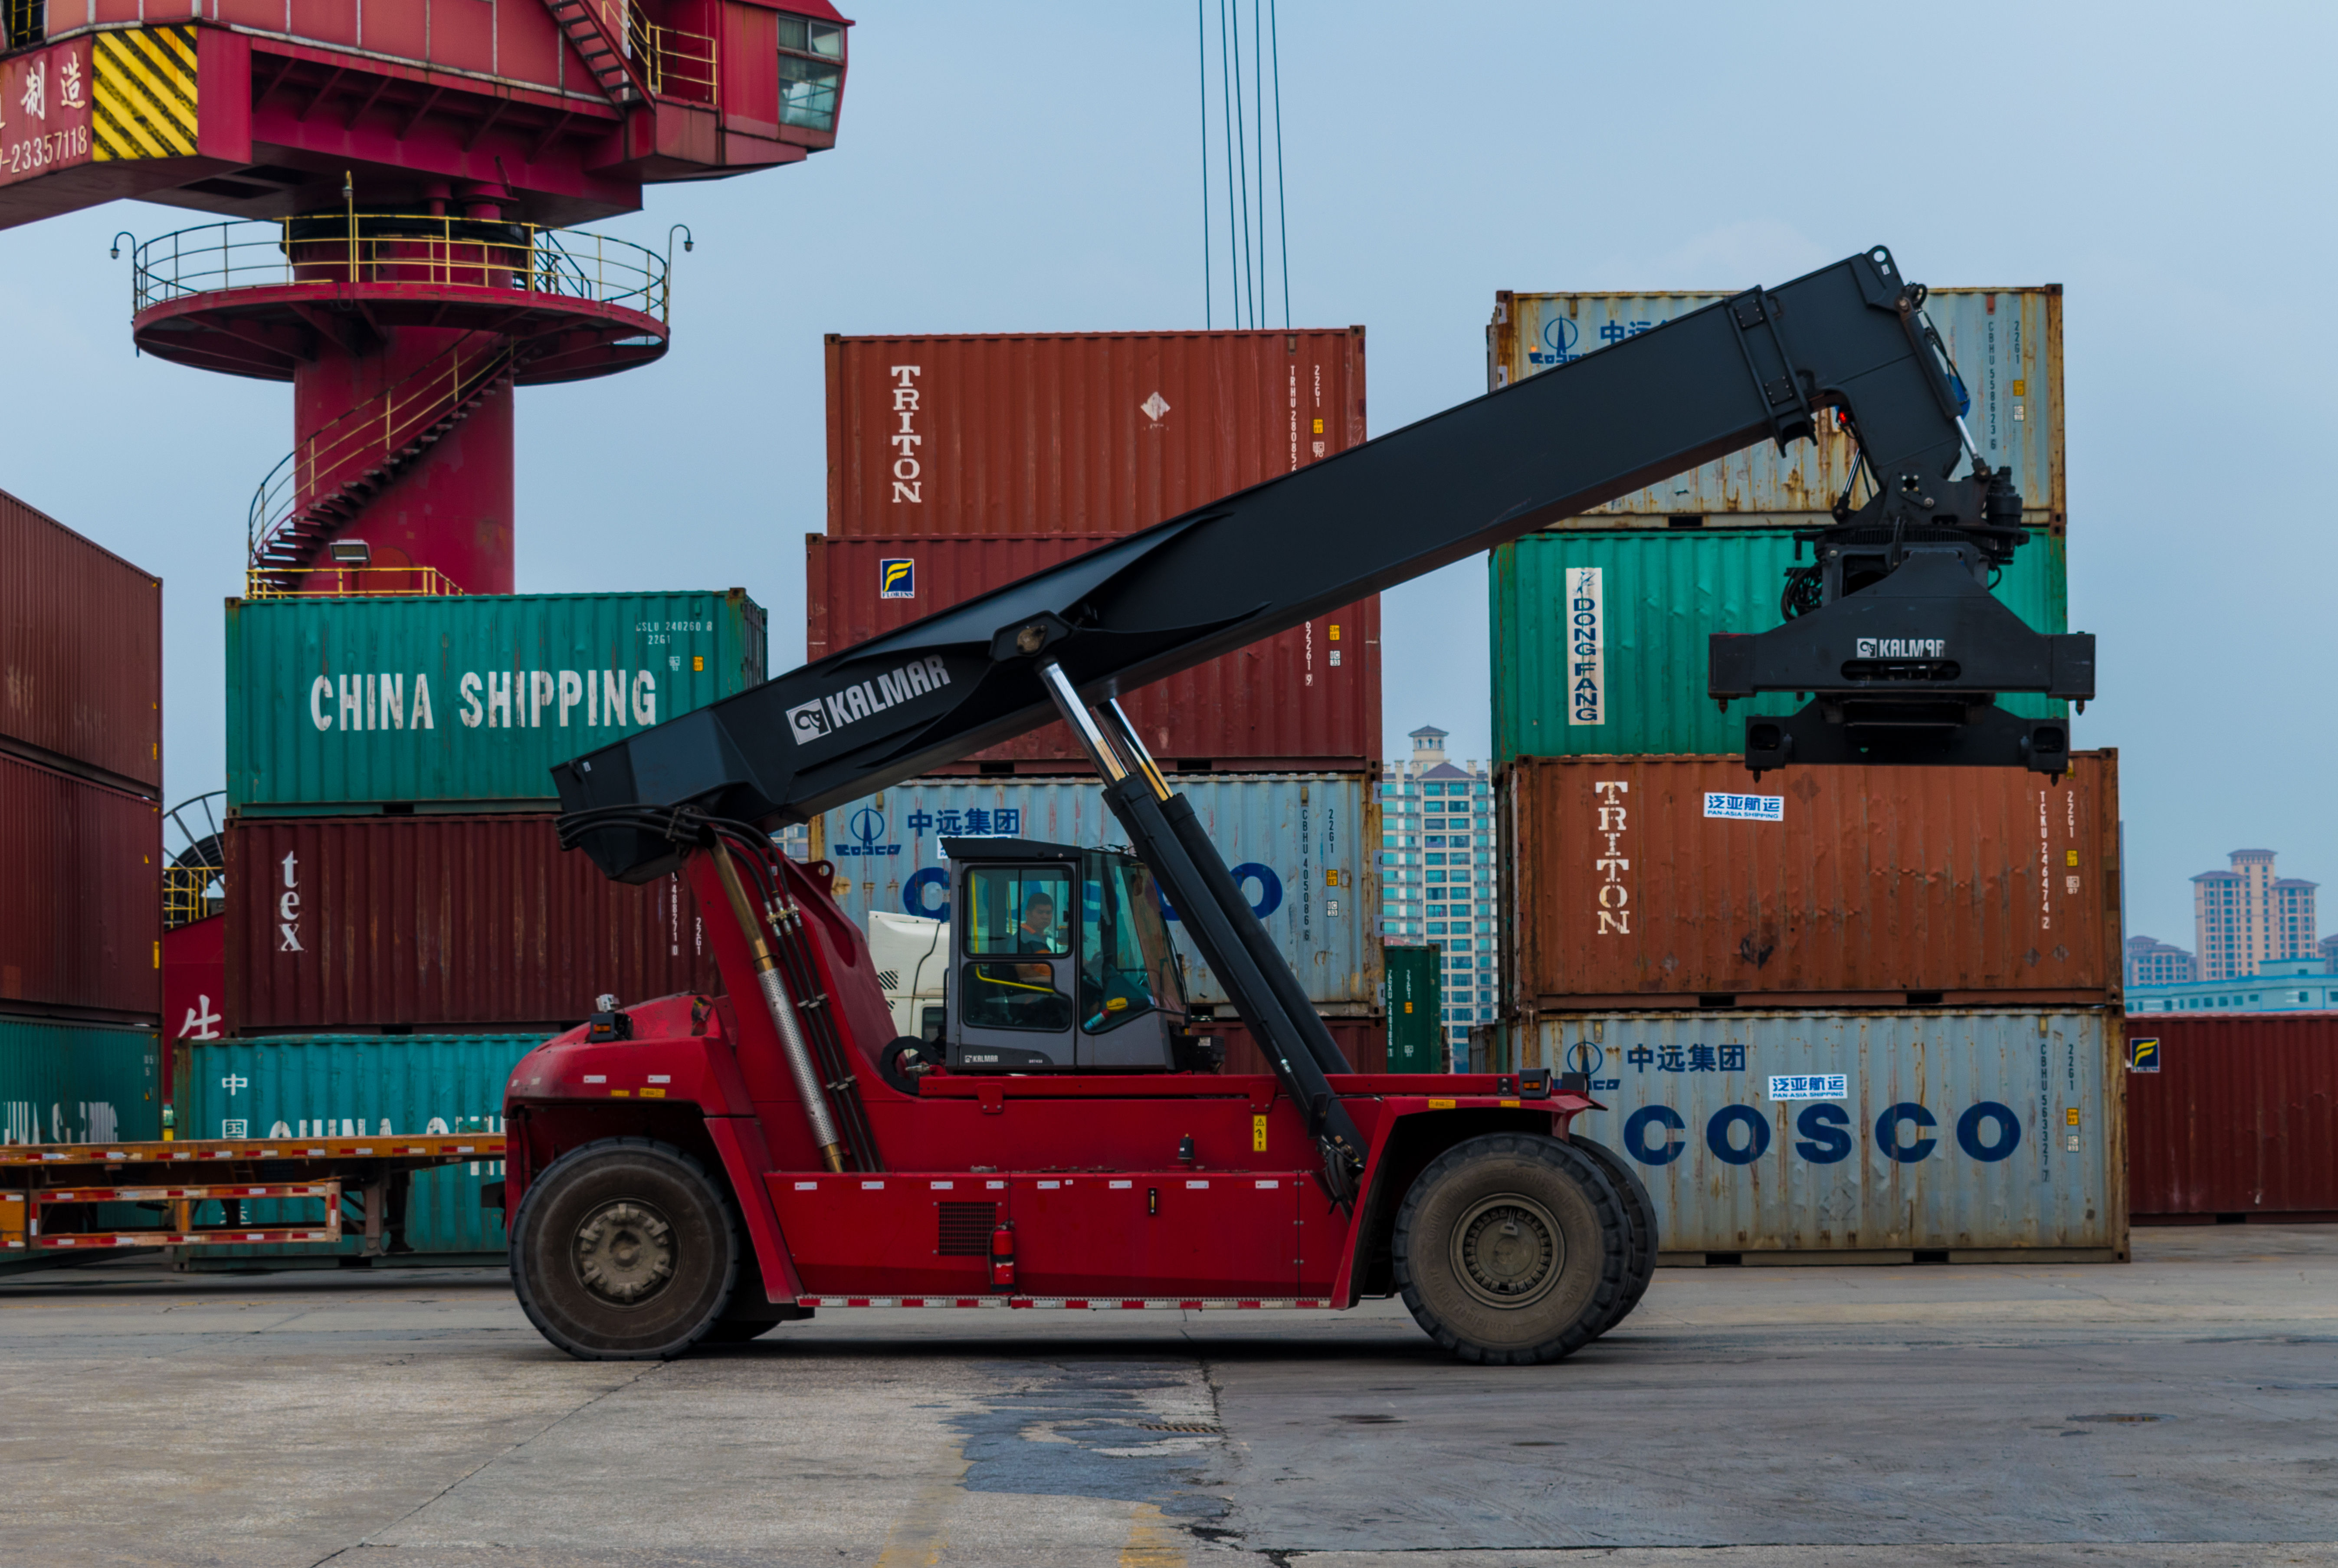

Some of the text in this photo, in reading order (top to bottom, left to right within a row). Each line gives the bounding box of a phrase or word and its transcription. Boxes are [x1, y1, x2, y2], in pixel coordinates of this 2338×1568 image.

[0, 125, 87, 173] -23357118
[891, 366, 921, 503] TRITON
[1990, 439, 1997, 449] 6
[648, 635, 670, 645] 22G1
[1879, 639, 1945, 657] KALMAR
[1573, 598, 1597, 721] DONG FANG
[311, 669, 656, 731] CHINA SHIPPING
[826, 654, 951, 728] KALMAR
[1708, 795, 1780, 812] 泛亚航运
[908, 808, 1020, 837] 中远集团
[1596, 782, 1630, 934] TRITON
[279, 851, 304, 951] tex
[1304, 930, 1309, 941] 6
[2042, 917, 2049, 929] 2
[1628, 1044, 1745, 1073] 中远集团
[1773, 1076, 1844, 1092] 泛亚航运
[1624, 1101, 2021, 1165] COSCO
